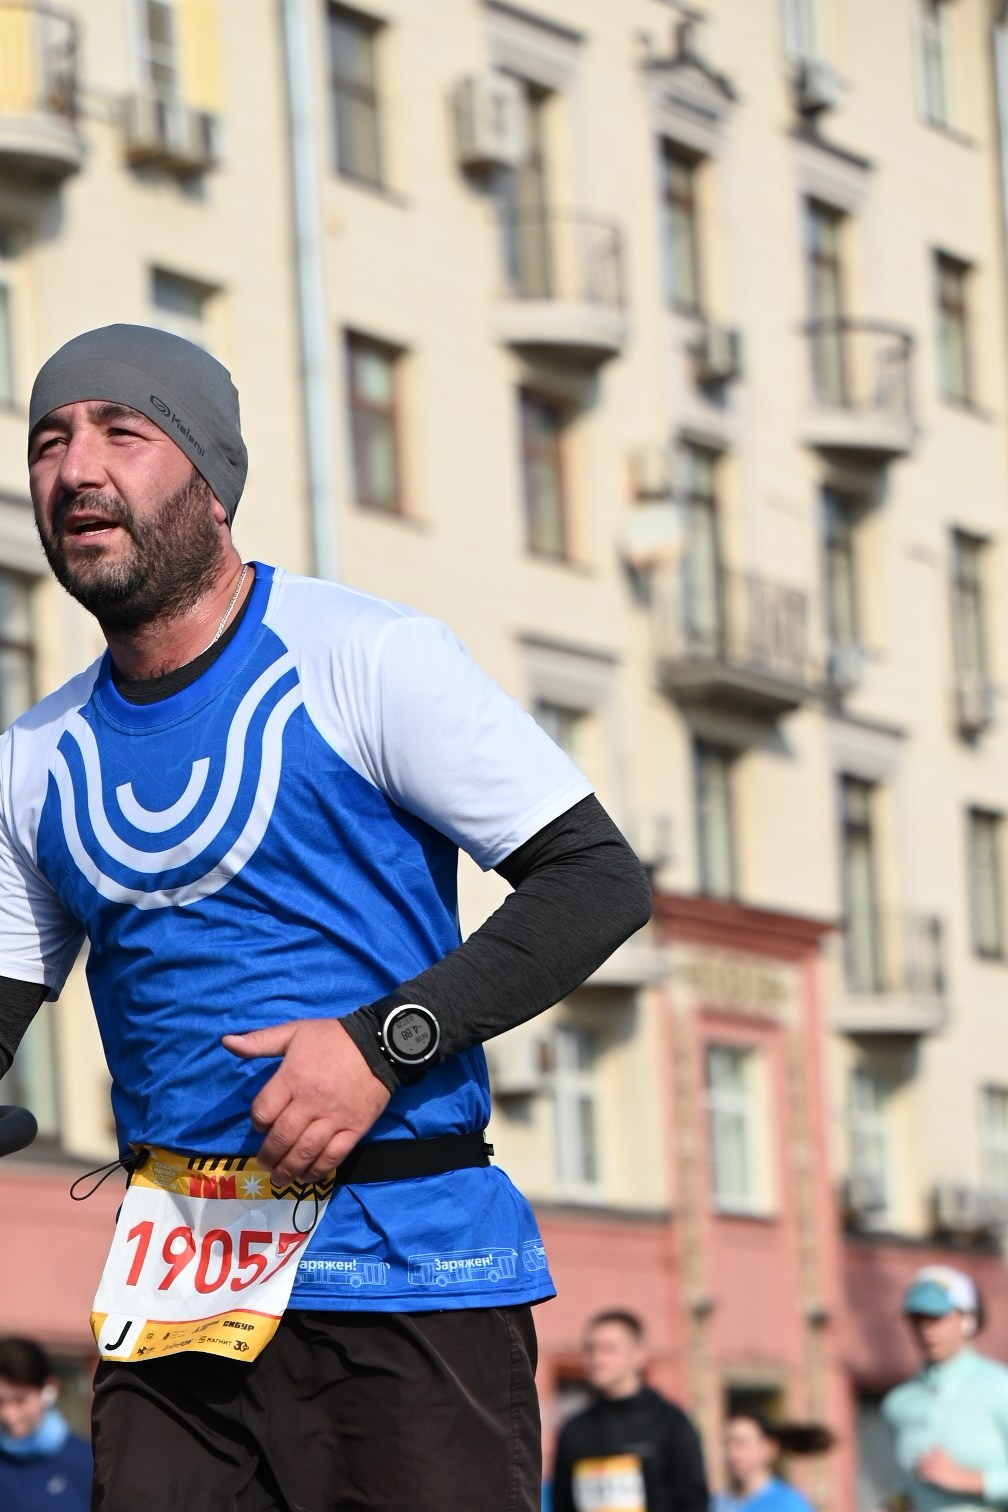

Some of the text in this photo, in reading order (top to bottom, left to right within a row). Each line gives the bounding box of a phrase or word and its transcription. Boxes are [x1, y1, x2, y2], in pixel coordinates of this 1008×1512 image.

[125, 1220, 311, 1295] 19057
[299, 1259, 357, 1272] аряжен!
[434, 1253, 493, 1272] Заряжен!
[222, 1320, 255, 1331] СИБУР
[104, 1320, 133, 1351] J
[206, 1337, 233, 1347] МАГНИТ
